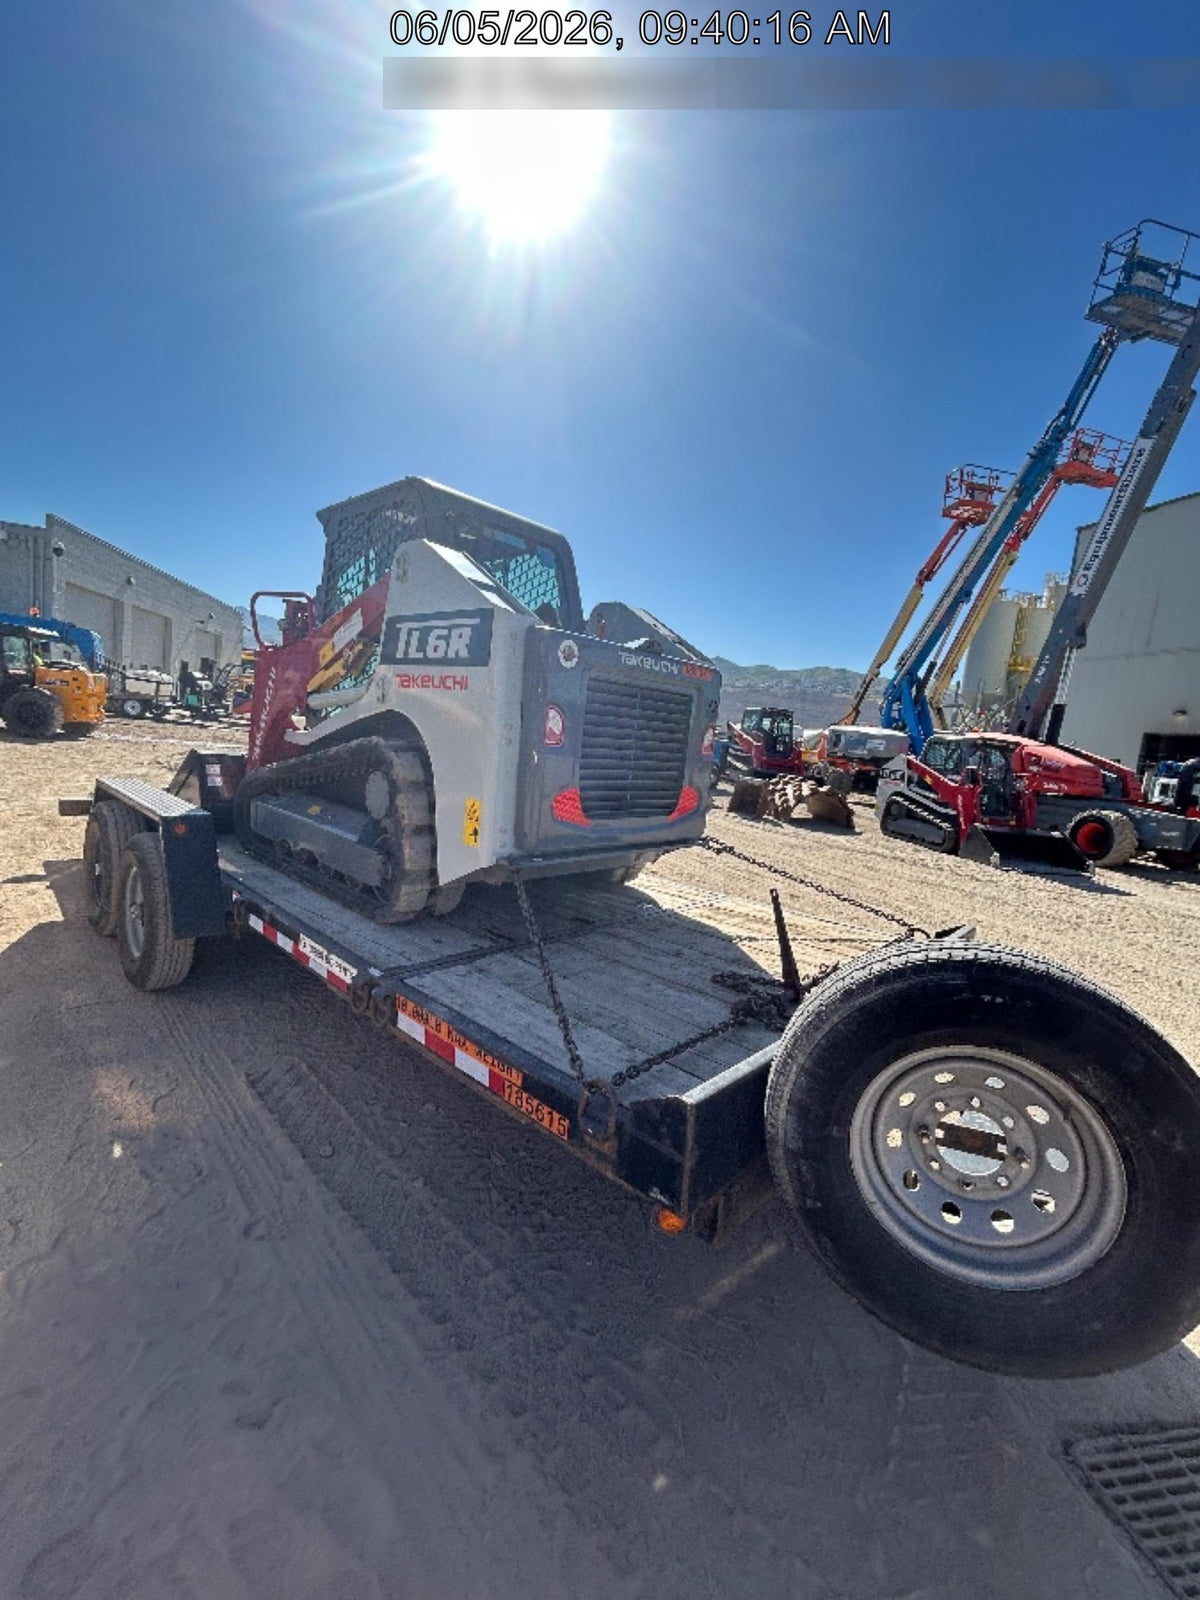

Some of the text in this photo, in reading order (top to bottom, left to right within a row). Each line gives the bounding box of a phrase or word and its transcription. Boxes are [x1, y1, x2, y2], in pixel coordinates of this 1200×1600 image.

[1083, 447, 1146, 572] EquipmentShare
[396, 618, 481, 658] TL6R
[618, 651, 680, 675] TAKEUCHI
[396, 673, 469, 692] TAKEUCHI
